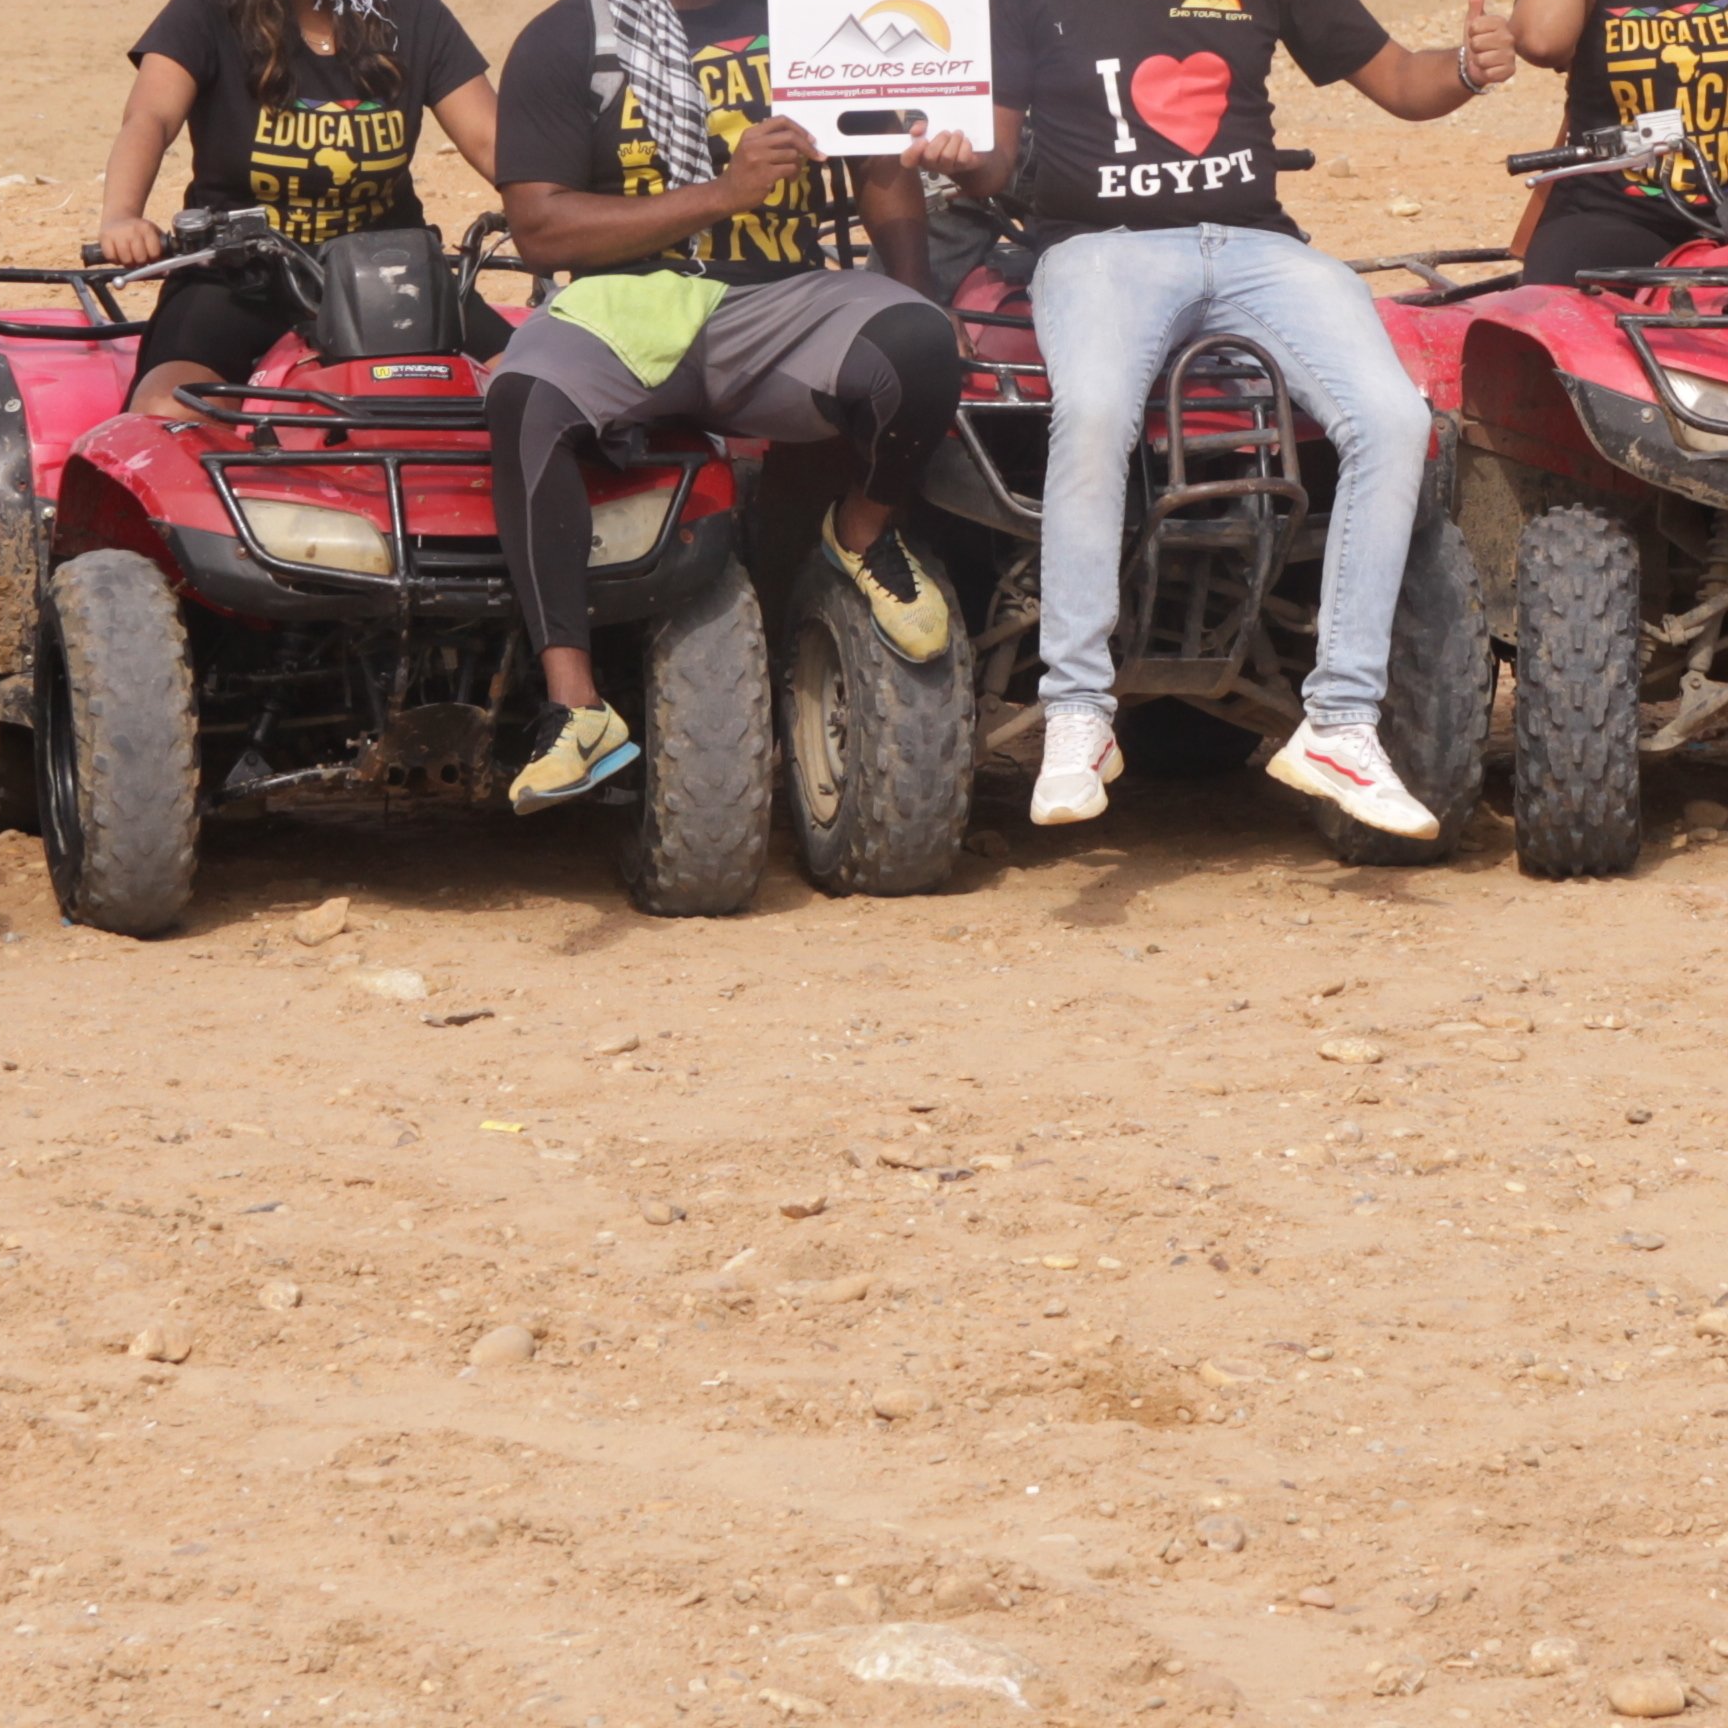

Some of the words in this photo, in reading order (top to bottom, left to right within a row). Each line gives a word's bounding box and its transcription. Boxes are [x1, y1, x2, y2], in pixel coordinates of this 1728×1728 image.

[1192, 10, 1222, 19] TOURS
[1225, 13, 1252, 21] EGYPT
[841, 63, 905, 78] TOURS
[911, 60, 974, 77] EGYPT
[886, 85, 977, 95] www.emotoursegypt.com
[1095, 58, 1137, 153] I
[254, 104, 405, 153] EDUCATED
[1098, 149, 1256, 198] EGYPT
